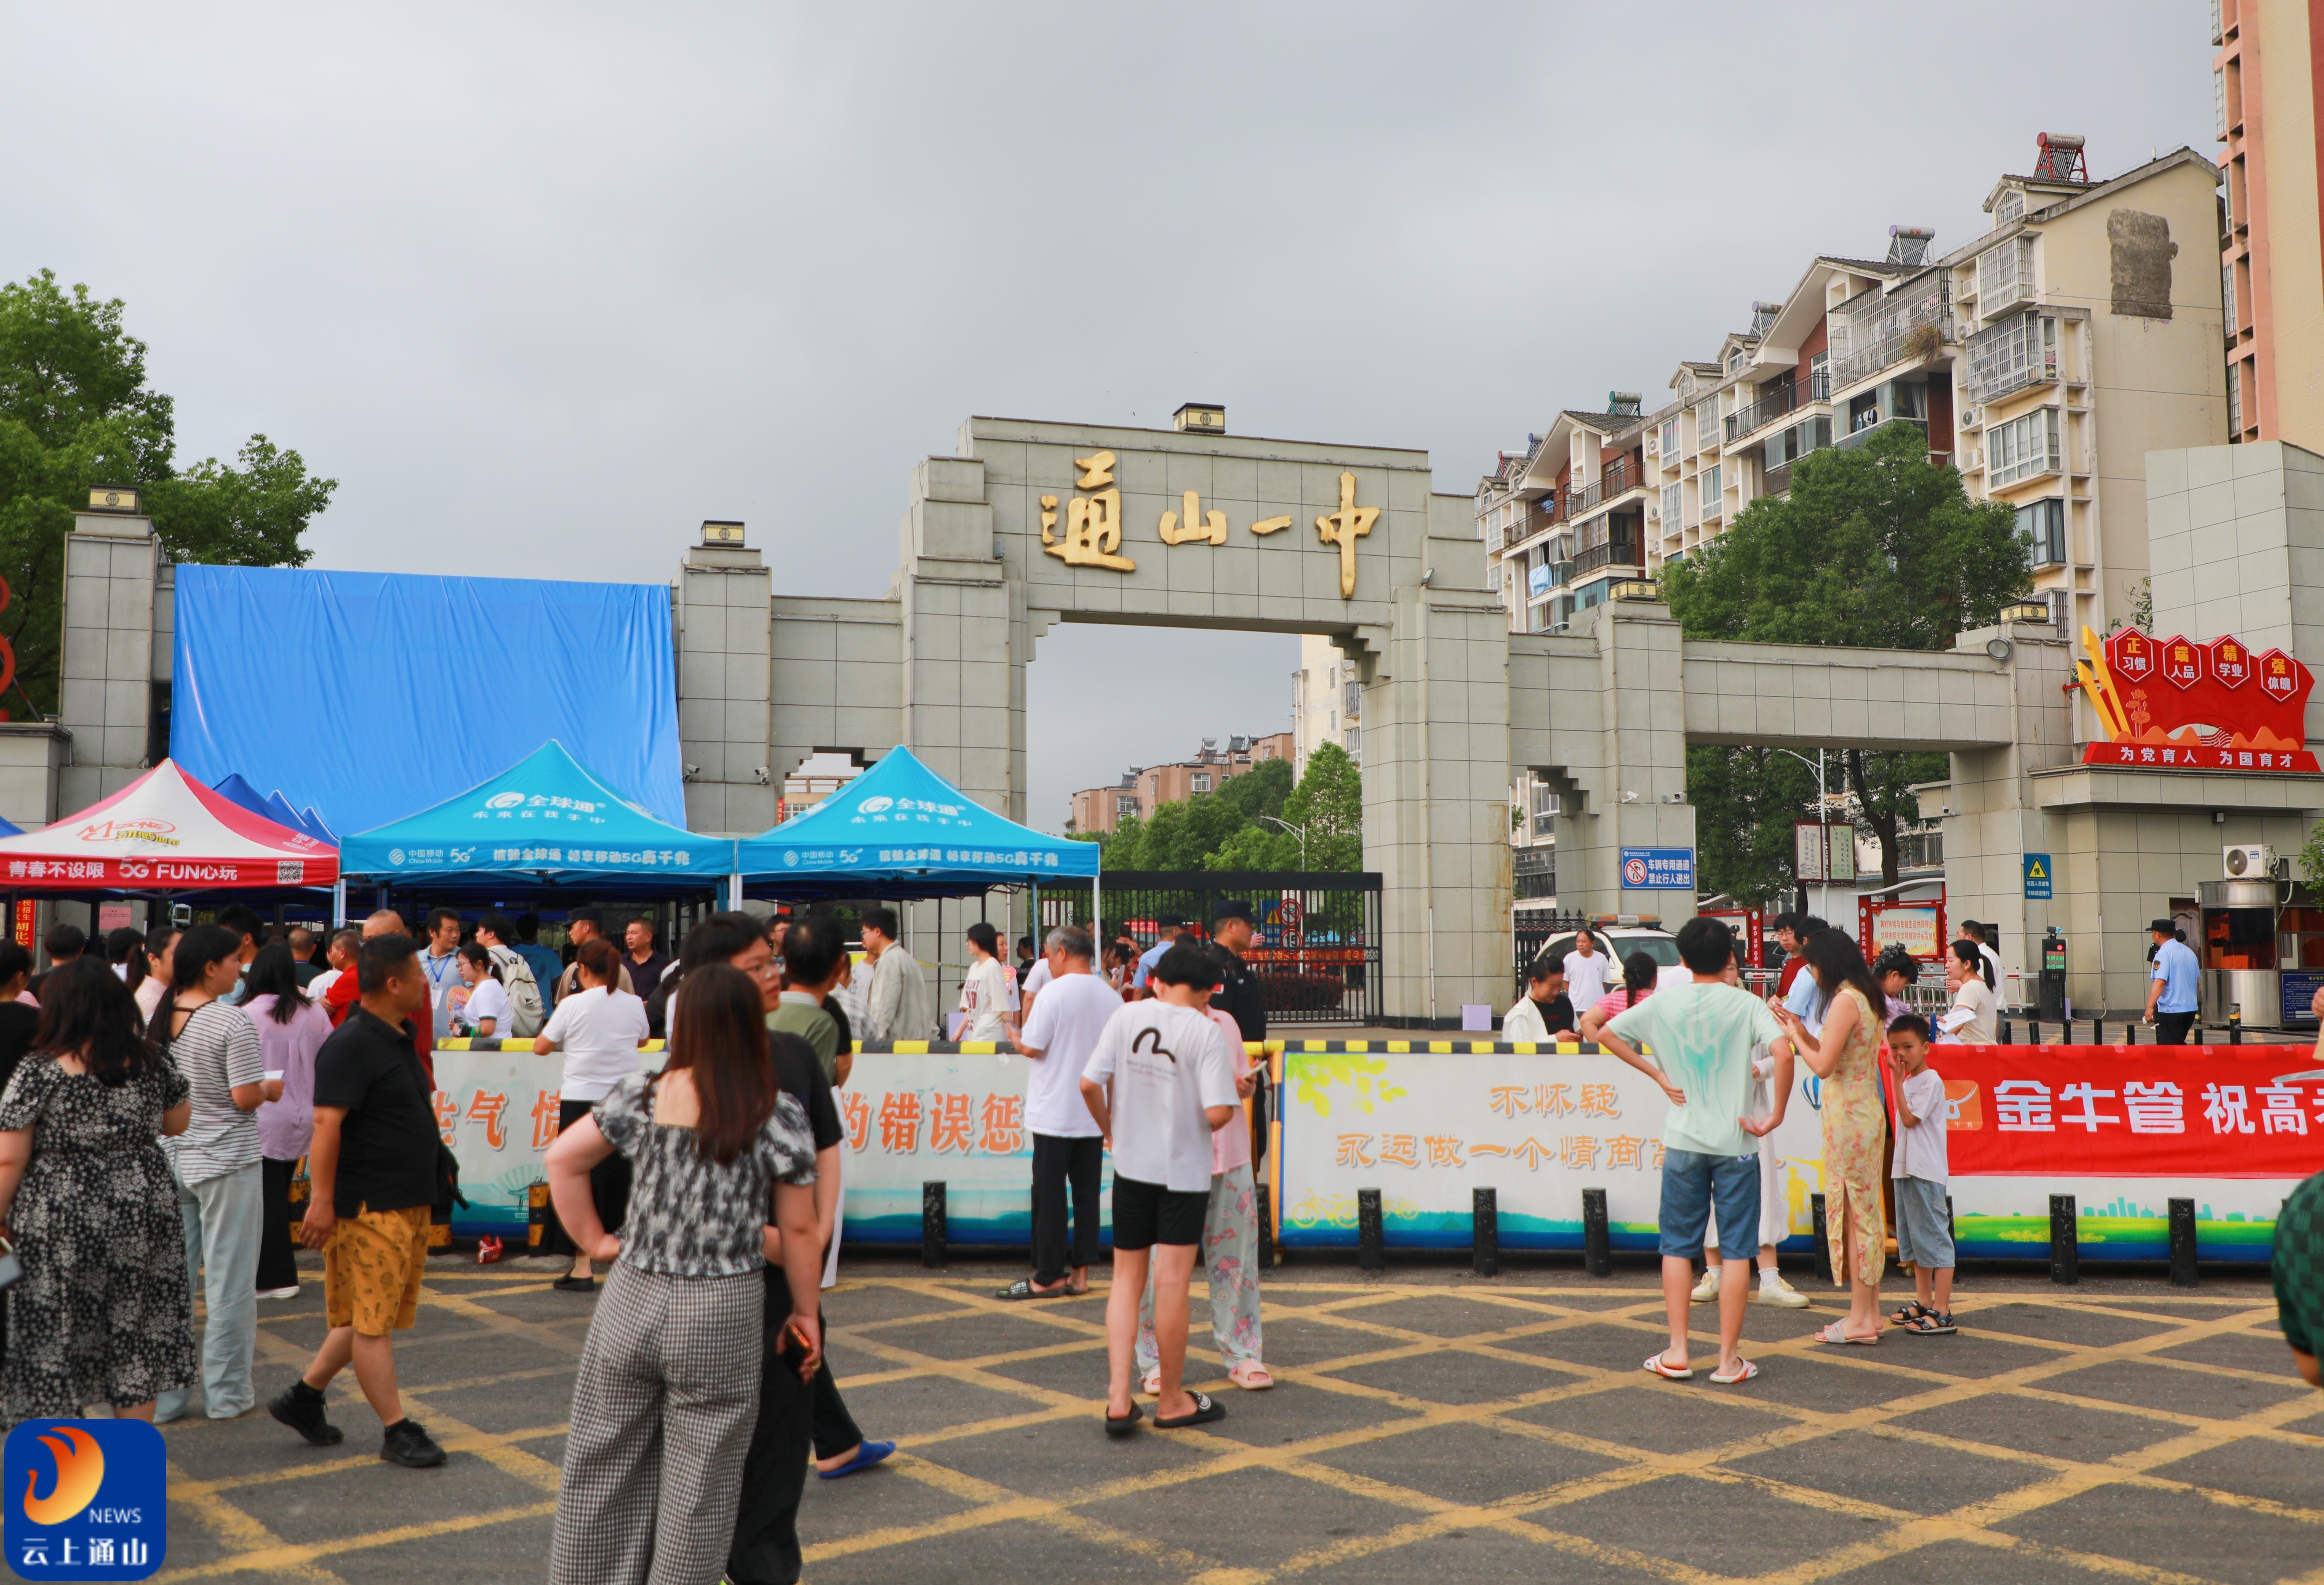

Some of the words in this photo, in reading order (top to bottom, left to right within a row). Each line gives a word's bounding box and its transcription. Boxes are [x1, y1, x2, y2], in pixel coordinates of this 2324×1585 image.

[1039, 451, 1381, 598] 通山一中
[2126, 637, 2141, 654] 正
[2174, 645, 2189, 663] 端
[2223, 644, 2237, 661] 精
[2123, 657, 2146, 671] 习惯
[2171, 665, 2195, 679] 人品
[2219, 663, 2243, 678] 学业
[2271, 658, 2286, 675] 强
[2268, 676, 2291, 691] 体魄
[2120, 747, 2197, 764] 为党育人
[2219, 752, 2293, 768] 为国育才
[473, 810, 605, 824] 未来在我手中
[851, 813, 972, 827] 未来在我手中
[116, 830, 180, 846] 动感地带
[494, 848, 561, 861] 信赖全球通
[568, 850, 690, 865] 畅享移动5G真千兆
[879, 849, 941, 862] 信赖全球通
[947, 850, 1058, 867] 畅享移动5G真千兆
[1648, 858, 1690, 870] 车辆专用通道
[9, 861, 105, 878] 青春不设限
[157, 864, 238, 880] FUN心玩
[1648, 873, 1690, 884] 禁止行人进出
[1880, 920, 1933, 929] 美好环境与幸福生活共同缔造
[1489, 1083, 1621, 1119] 不怀疑
[1994, 1080, 2185, 1133] 金牛管
[2201, 1082, 2324, 1135] 祝高
